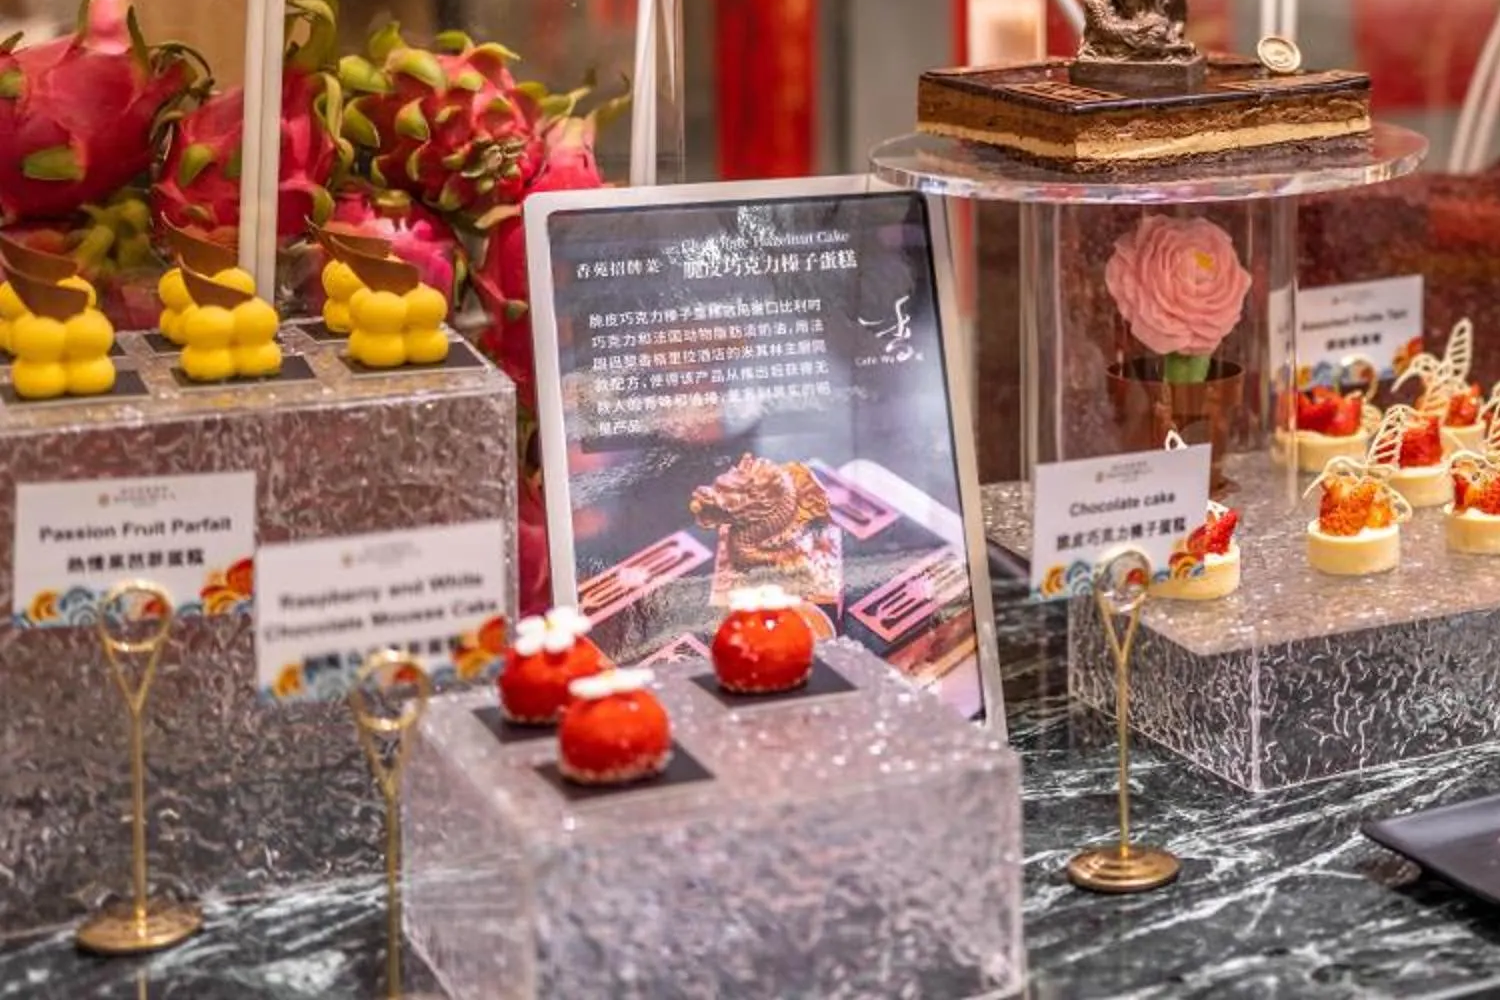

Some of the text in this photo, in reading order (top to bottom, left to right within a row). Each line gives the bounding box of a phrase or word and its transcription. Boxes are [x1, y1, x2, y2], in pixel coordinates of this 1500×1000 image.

[816, 229, 850, 244] Cake
[1069, 490, 1176, 517] Chocolate cake
[39, 517, 232, 543] Passion Fruit Parfait
[279, 574, 484, 610] Raspberry and White
[372, 607, 445, 626] Mousse
[452, 599, 498, 616] Cake
